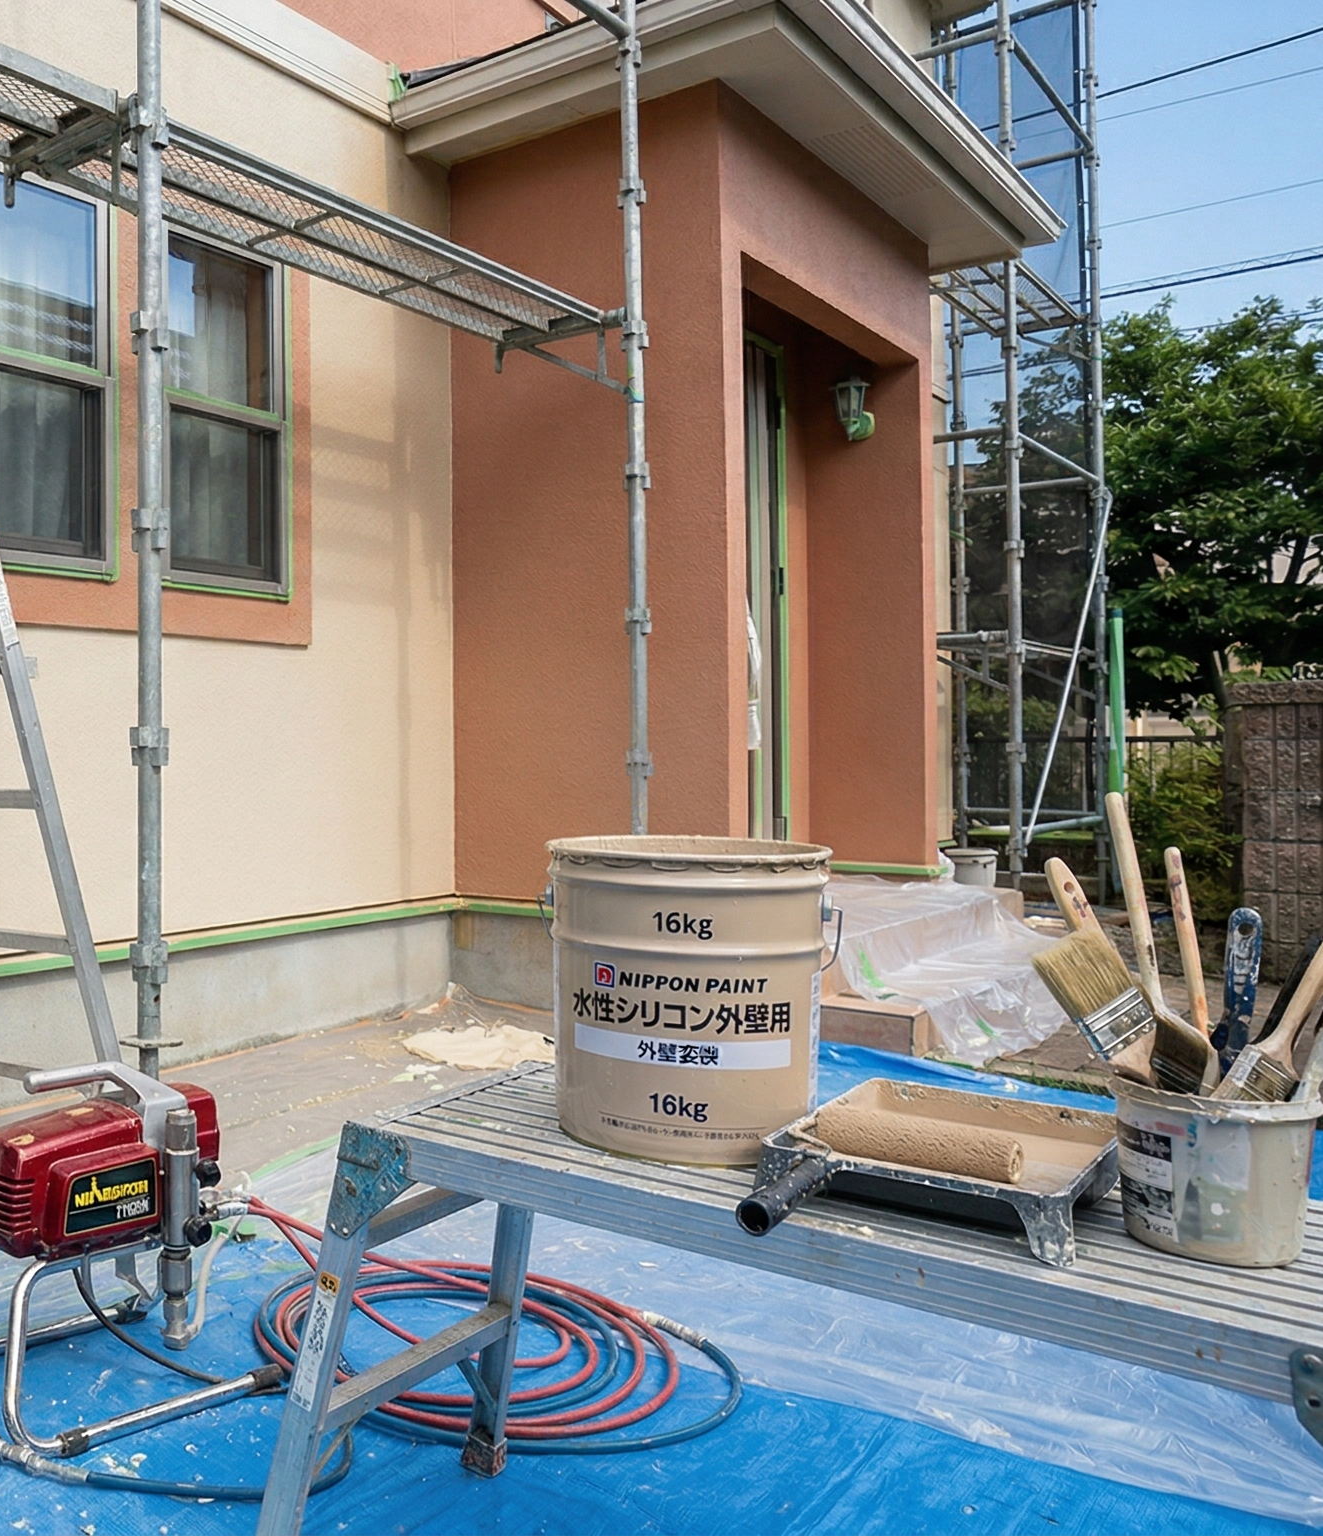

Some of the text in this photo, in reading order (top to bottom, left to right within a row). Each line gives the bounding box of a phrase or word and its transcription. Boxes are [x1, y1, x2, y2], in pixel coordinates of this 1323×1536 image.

[652, 911, 713, 940] 16kg
[618, 971, 768, 994] NIPPON PAINT
[572, 987, 791, 1035] 水性シリコン外壁用
[648, 1092, 709, 1123] 16kg
